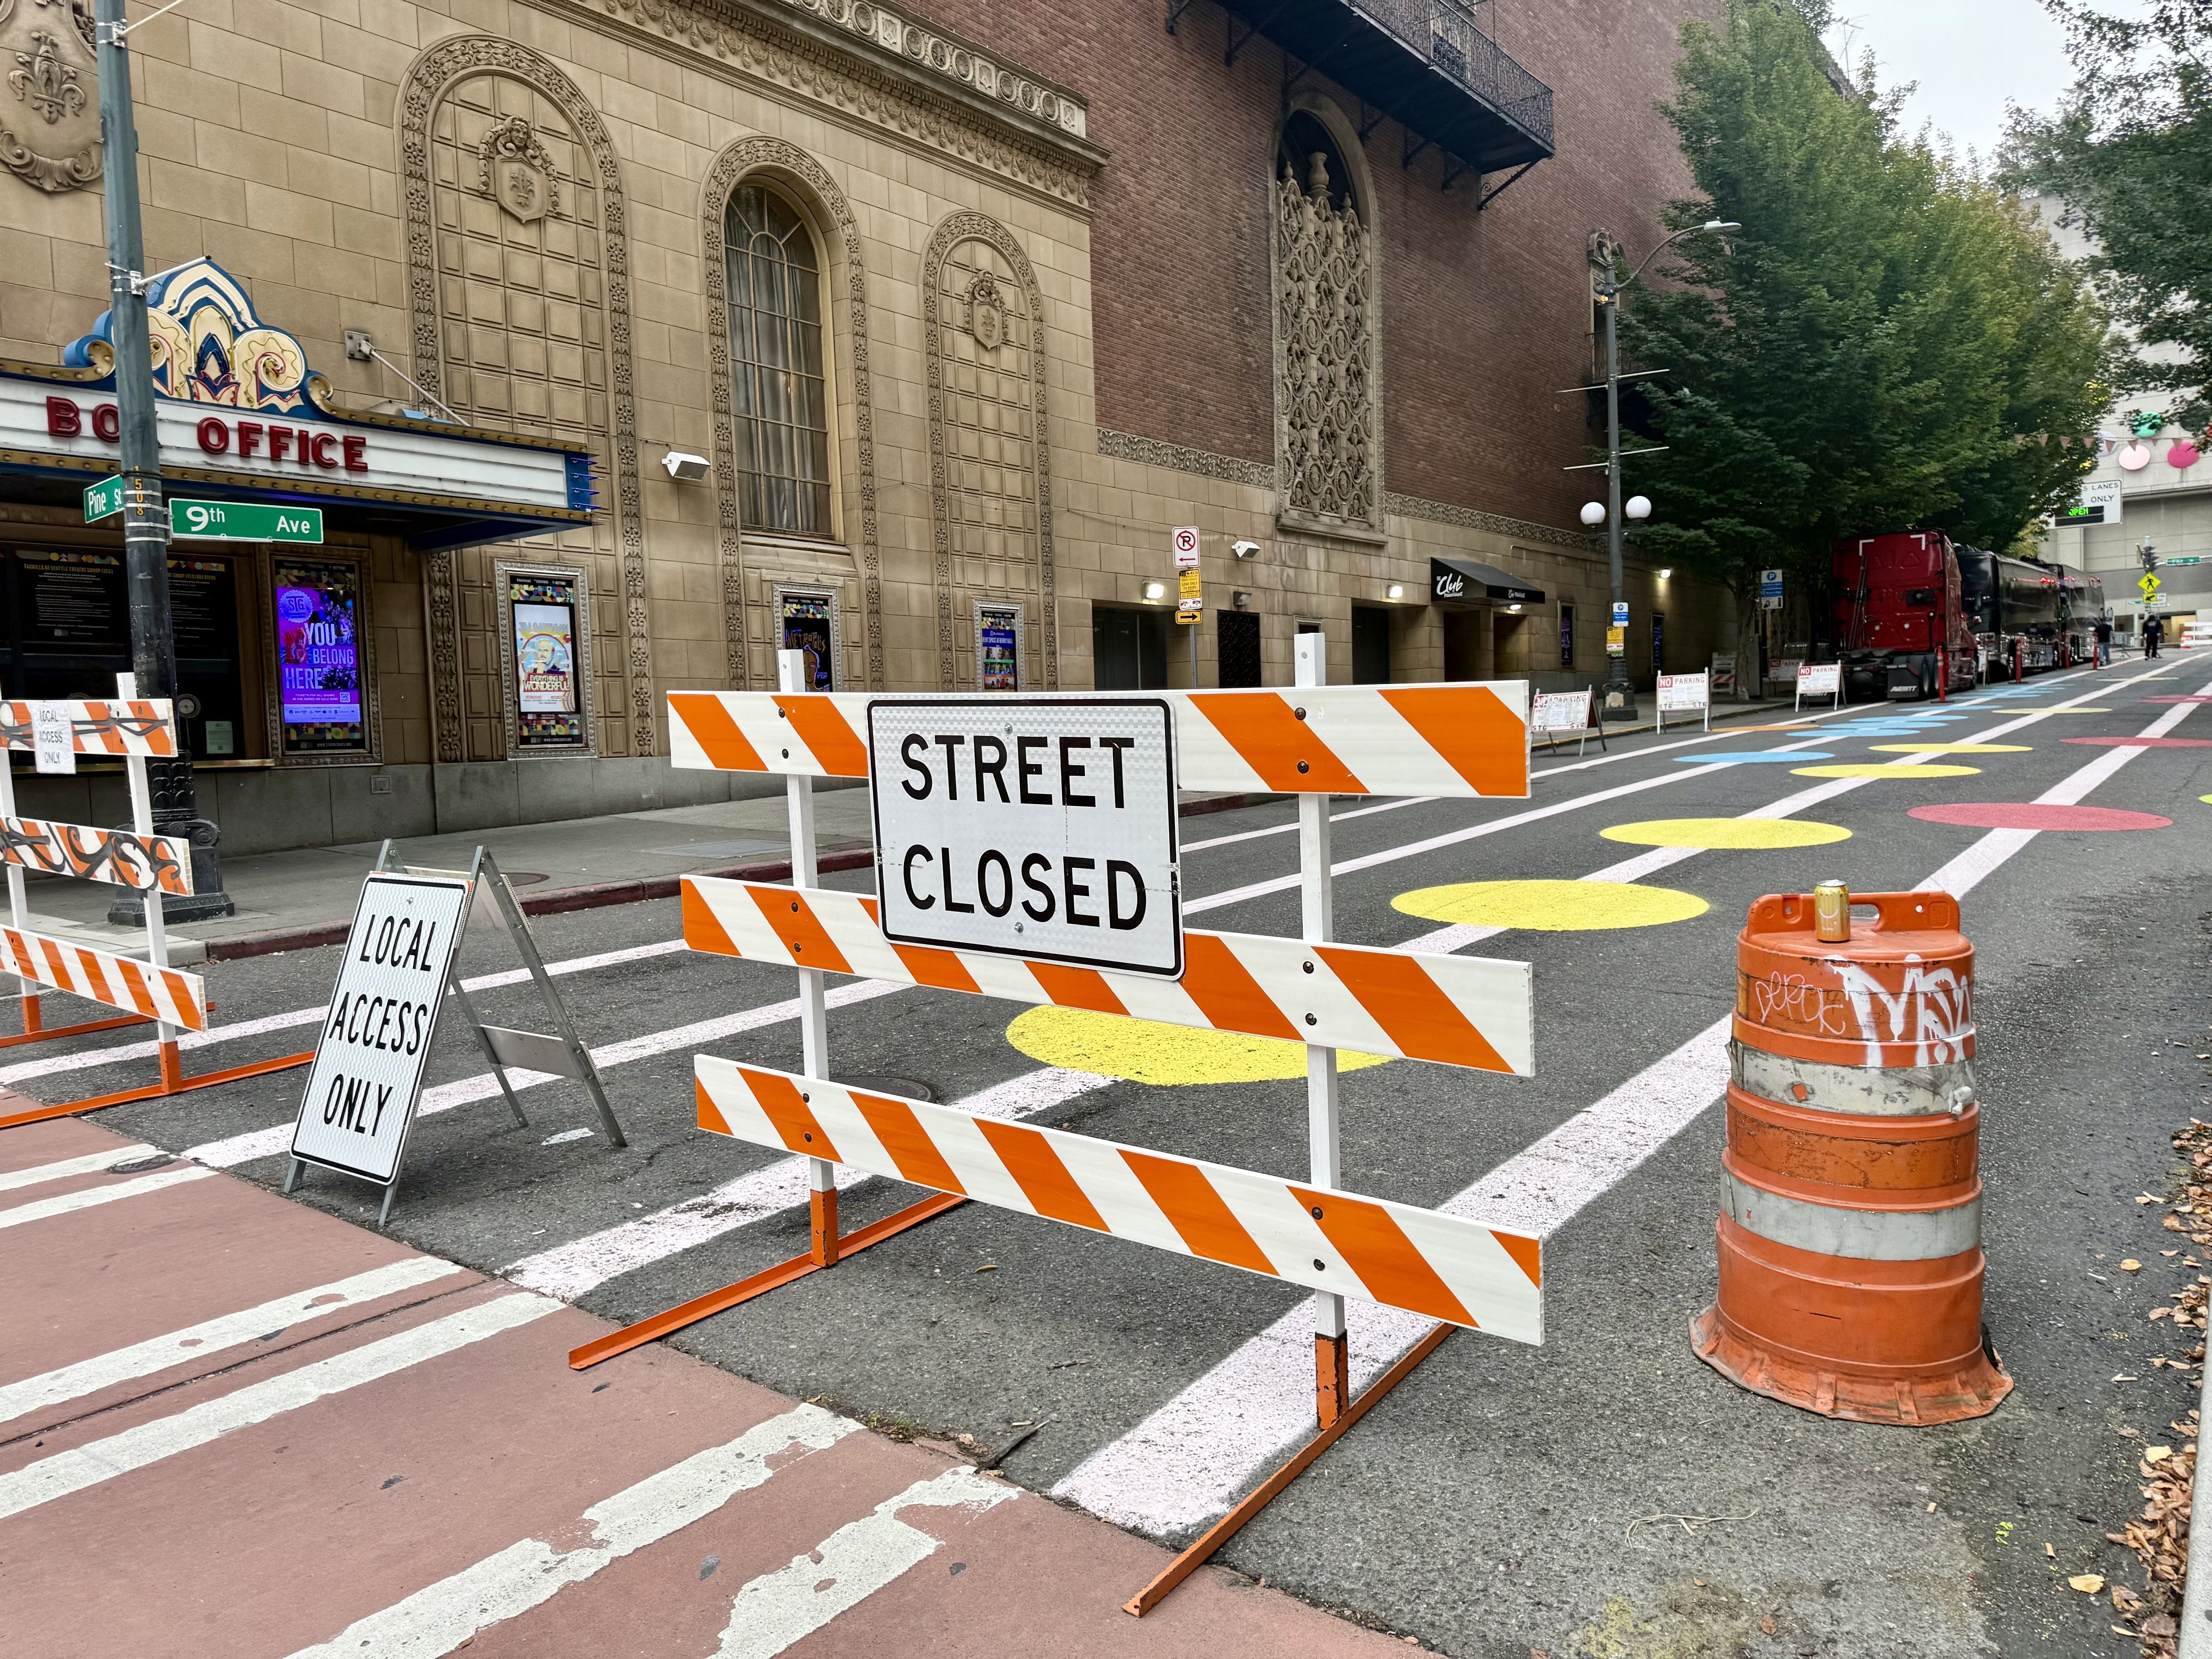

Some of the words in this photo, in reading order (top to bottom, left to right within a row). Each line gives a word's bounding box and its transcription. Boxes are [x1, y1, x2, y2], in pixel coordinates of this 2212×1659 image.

[197, 417, 368, 472] OFFICE
[88, 490, 106, 516] Pine
[114, 488, 122, 506] St
[2091, 495, 2114, 503] ONLY
[186, 506, 225, 532] 9th
[276, 515, 311, 534] Ave
[1436, 573, 1463, 595] Club
[286, 596, 304, 611] STG
[304, 622, 336, 646] YOU
[313, 648, 354, 665] BELONG
[285, 668, 323, 689] HERE
[523, 678, 570, 691] WONDERFUL!
[1660, 678, 1671, 687] NO
[1675, 676, 1705, 684] PARKING
[40, 710, 59, 722] LOCAL
[40, 731, 63, 743] ACCESS
[45, 752, 60, 764] ONLY
[901, 733, 1135, 809] STREET
[903, 844, 1147, 931] CLOSED
[359, 914, 436, 972] LOCAL
[328, 991, 428, 1056] ACCESS
[324, 1073, 393, 1137] ONLY
